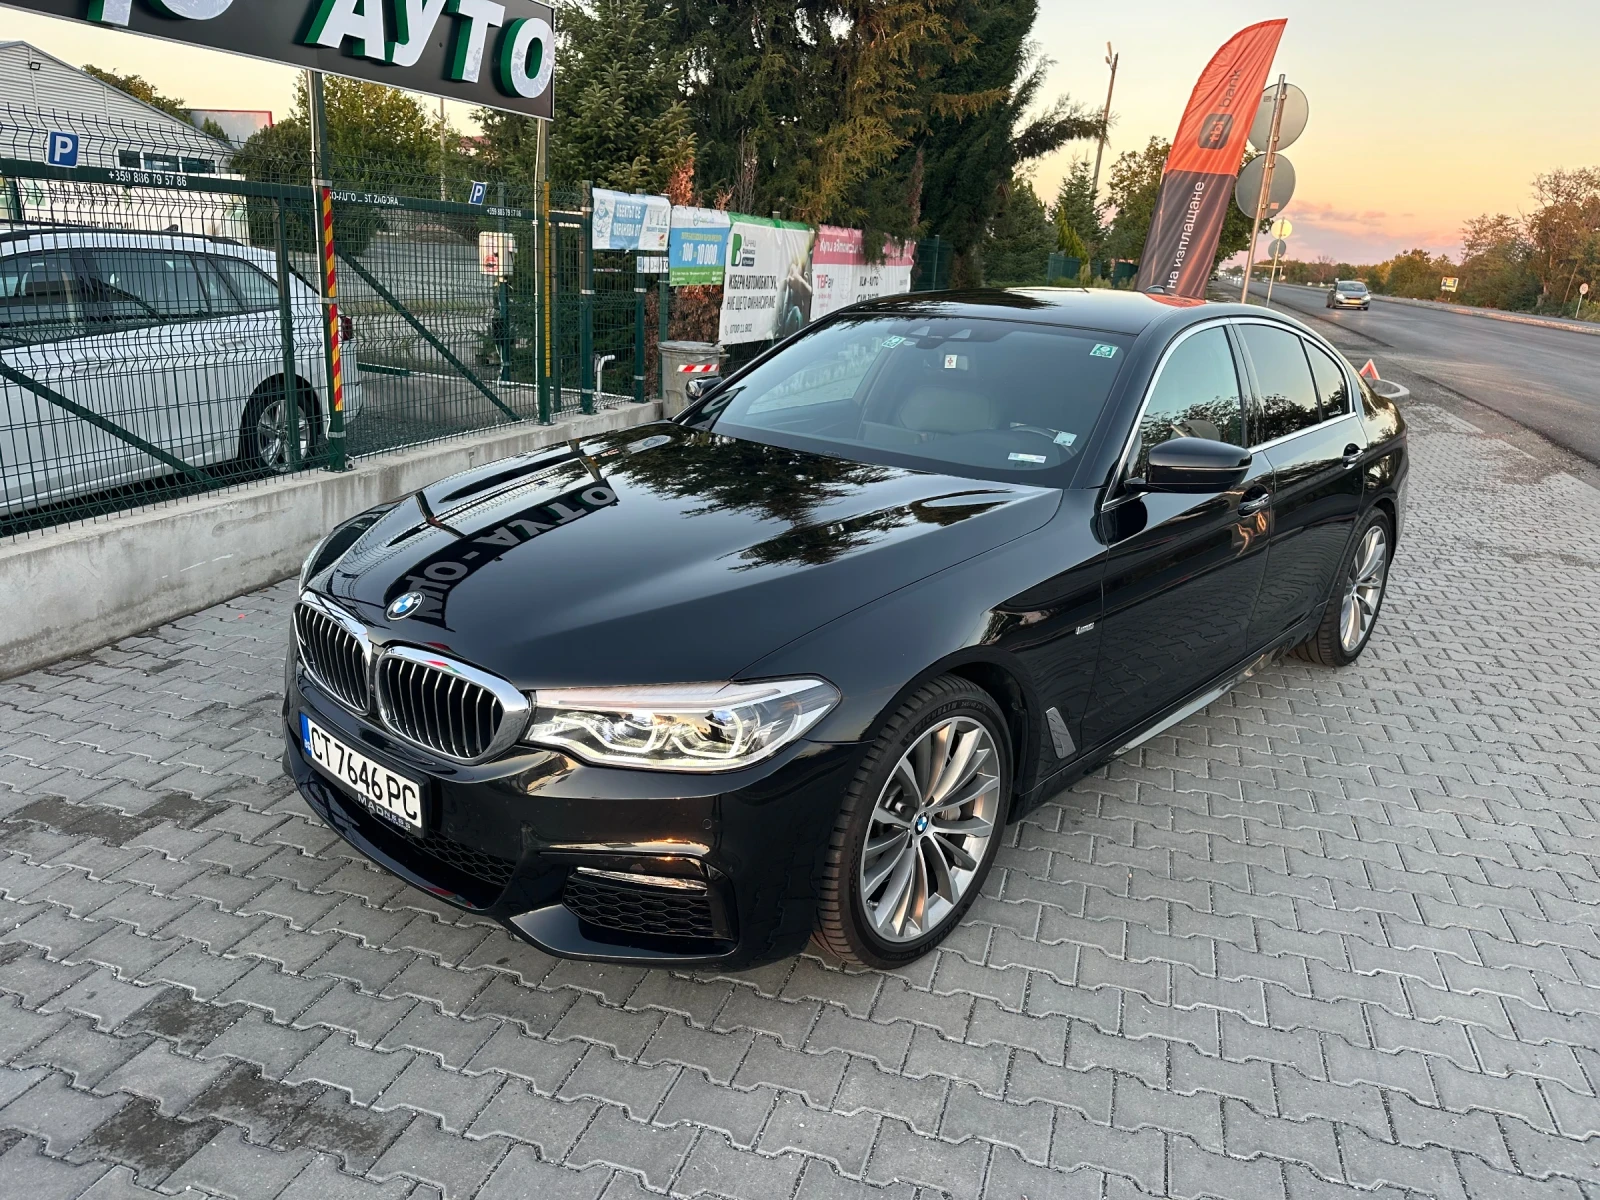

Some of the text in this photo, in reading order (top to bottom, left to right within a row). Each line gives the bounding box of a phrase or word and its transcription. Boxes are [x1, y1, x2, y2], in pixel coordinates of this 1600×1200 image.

[305, 0, 554, 98] АУТО
[1219, 68, 1242, 108] bank
[53, 134, 74, 161] P
[108, 170, 130, 182] +359
[152, 173, 162, 185] 79
[164, 175, 174, 186] 57
[176, 176, 187, 187] 86
[374, 195, 398, 206] ZAGORA
[682, 242, 693, 262] 100
[1166, 181, 1206, 290] на изплащане
[334, 743, 383, 801] 7646
